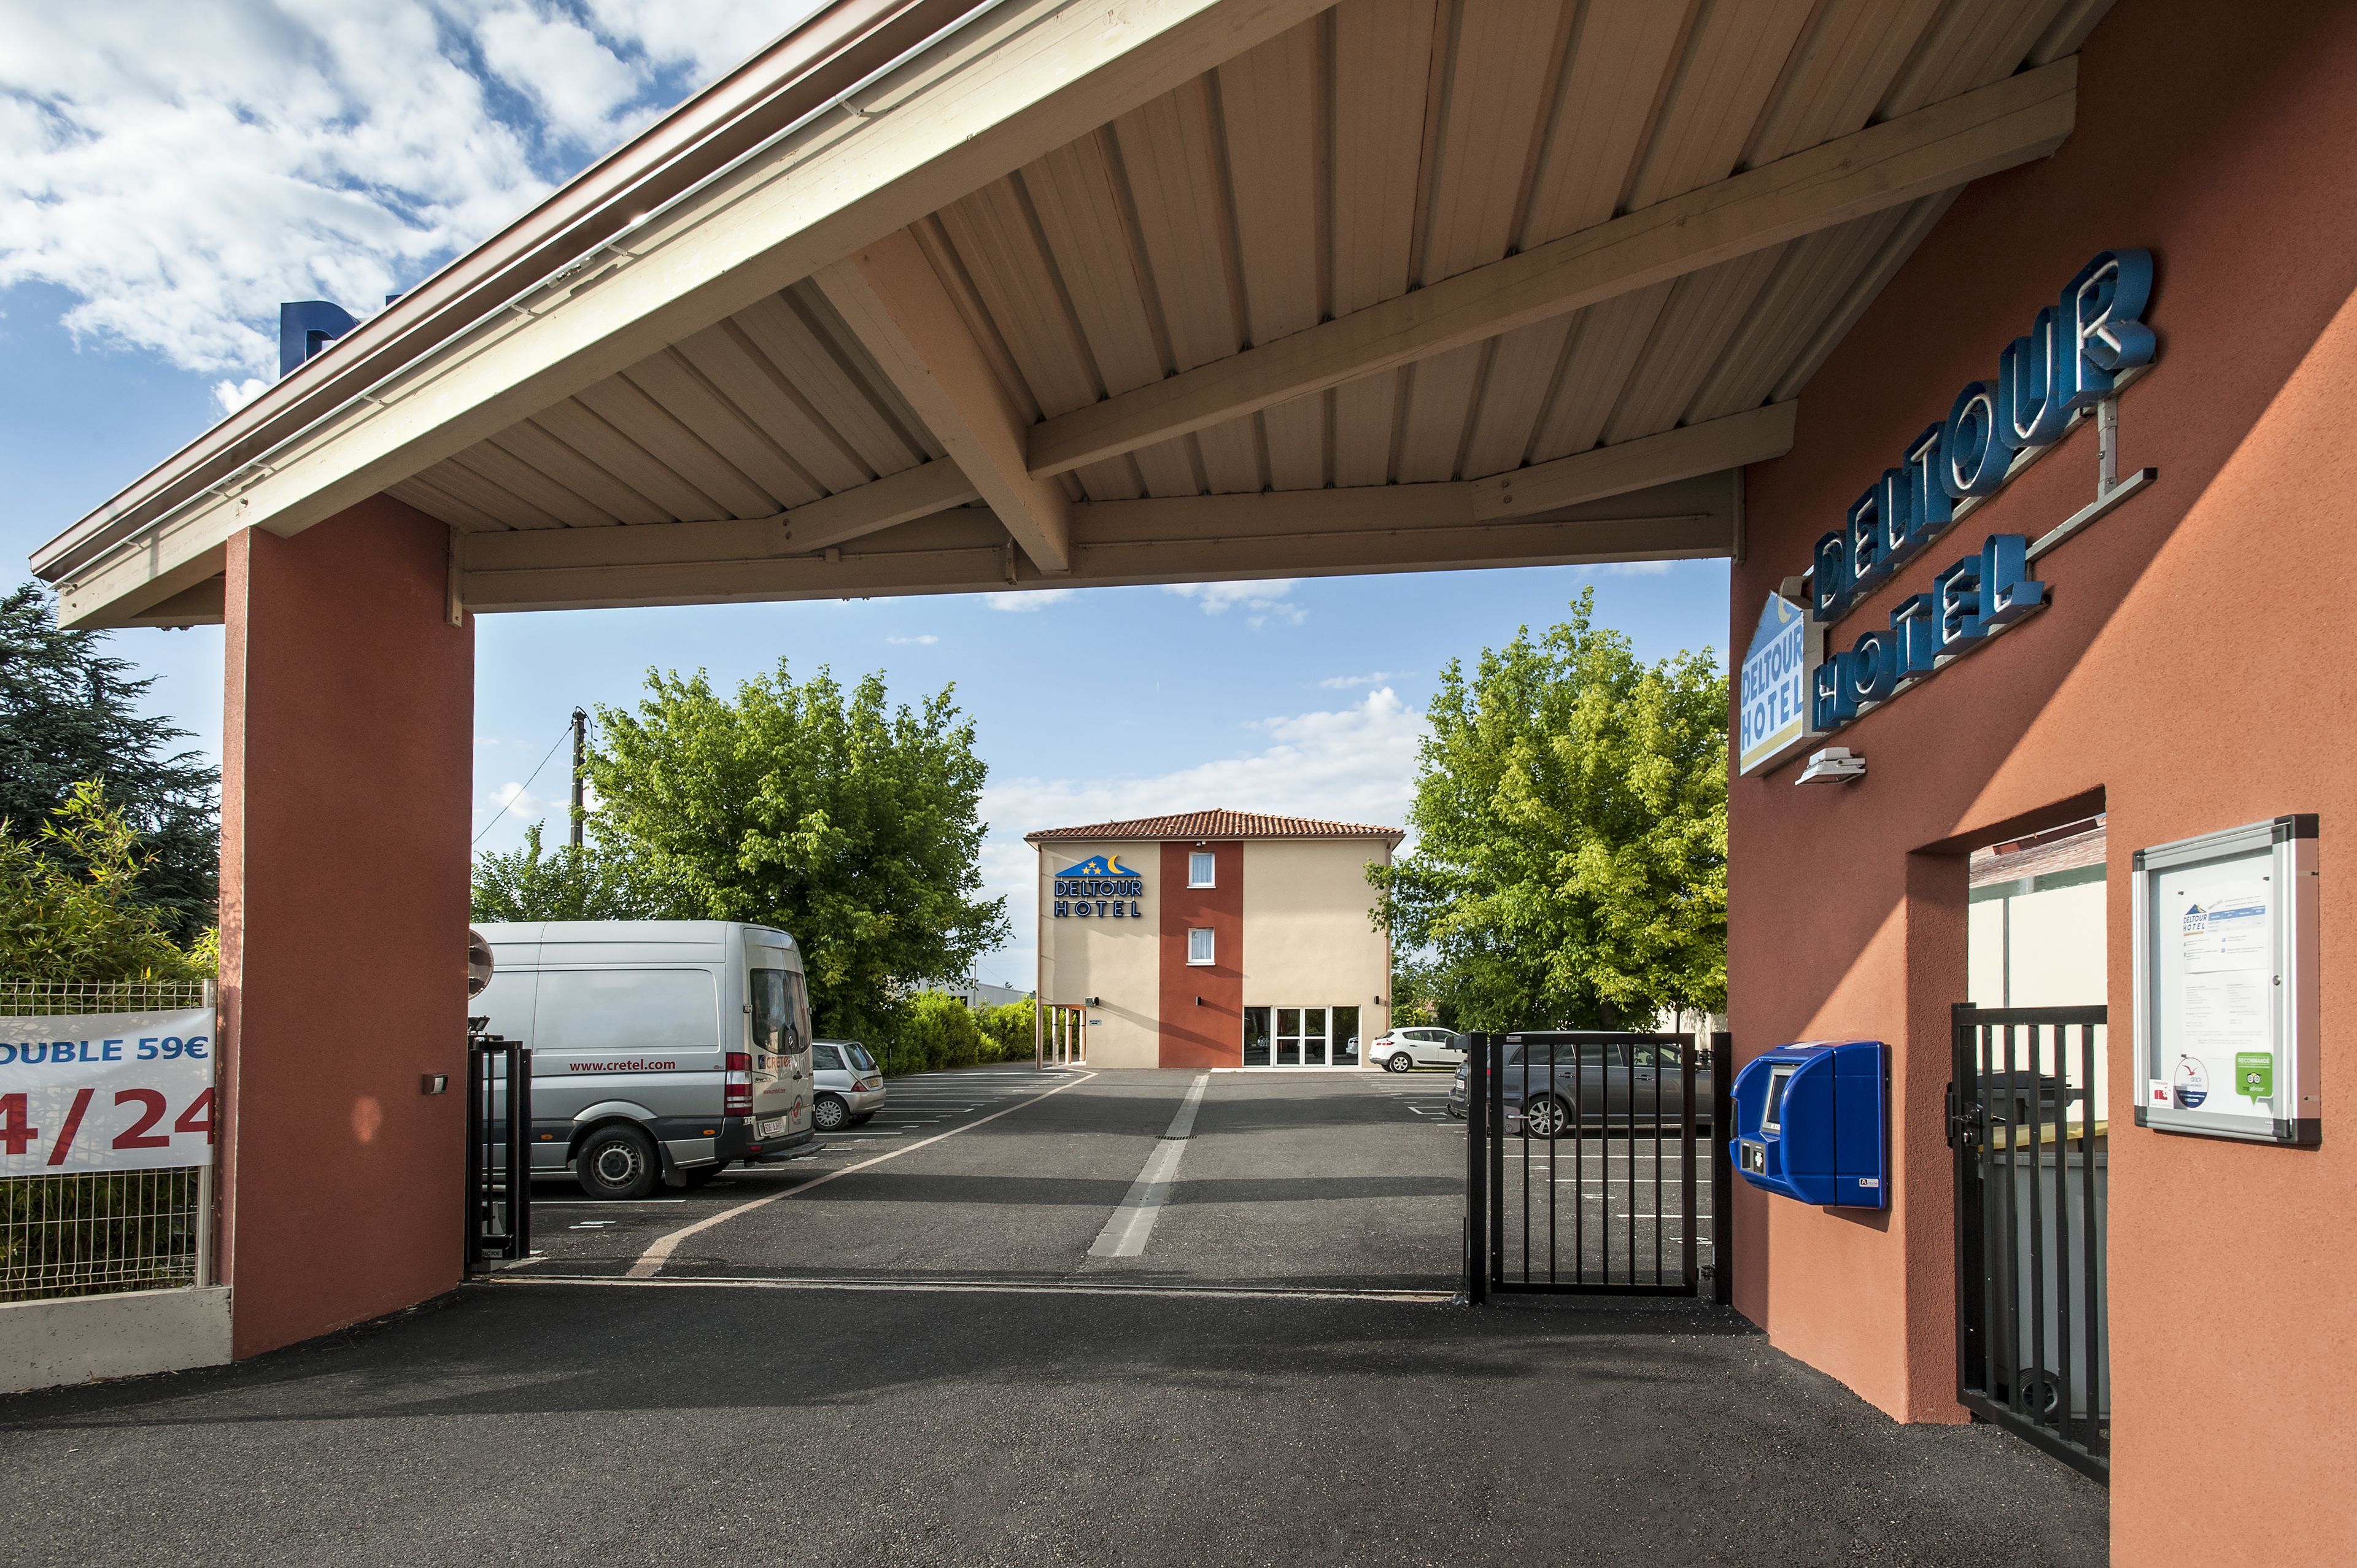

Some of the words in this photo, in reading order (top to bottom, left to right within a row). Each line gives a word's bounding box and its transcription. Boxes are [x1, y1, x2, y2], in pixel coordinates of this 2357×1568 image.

[1813, 247, 2156, 622] DELTOUR
[1811, 533, 2045, 732] HOTEL
[1742, 624, 1803, 708] DELTOUR
[1741, 674, 1803, 751] HOTEL
[1055, 880, 1142, 897] DELTOUR
[1055, 900, 1141, 917] HOTEL
[2183, 914, 2207, 924] DELTOUR
[2183, 922, 2205, 932] HOTEL
[137, 1036, 209, 1060] 59€
[570, 1059, 676, 1071] www.cretel.com
